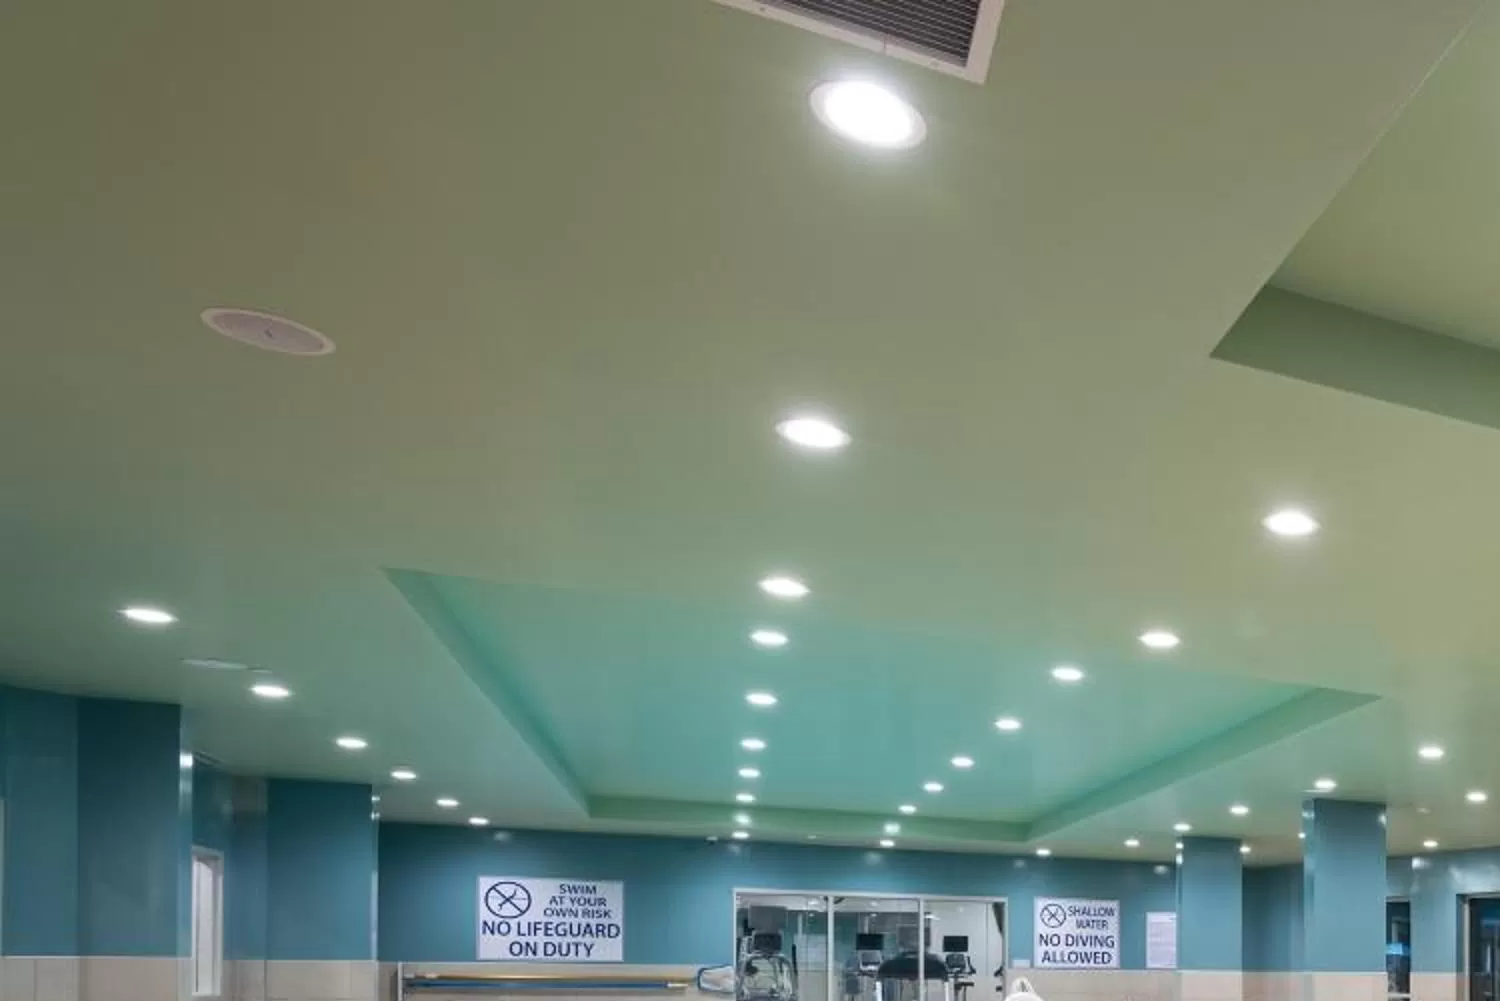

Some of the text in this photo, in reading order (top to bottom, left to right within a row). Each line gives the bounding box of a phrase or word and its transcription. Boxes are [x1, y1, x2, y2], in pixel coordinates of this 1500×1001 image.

[559, 883, 597, 895] SWIM
[550, 895, 607, 907] AT YOUR
[543, 907, 612, 919] OWN RISK
[1068, 905, 1115, 917] SHALLOW
[481, 920, 621, 939] NO LIFEGUARD
[1075, 919, 1109, 930] WATER
[1039, 933, 1115, 948] NO DIVING
[509, 941, 595, 958] ON DUTY
[1041, 951, 1112, 965] ALLOWED
